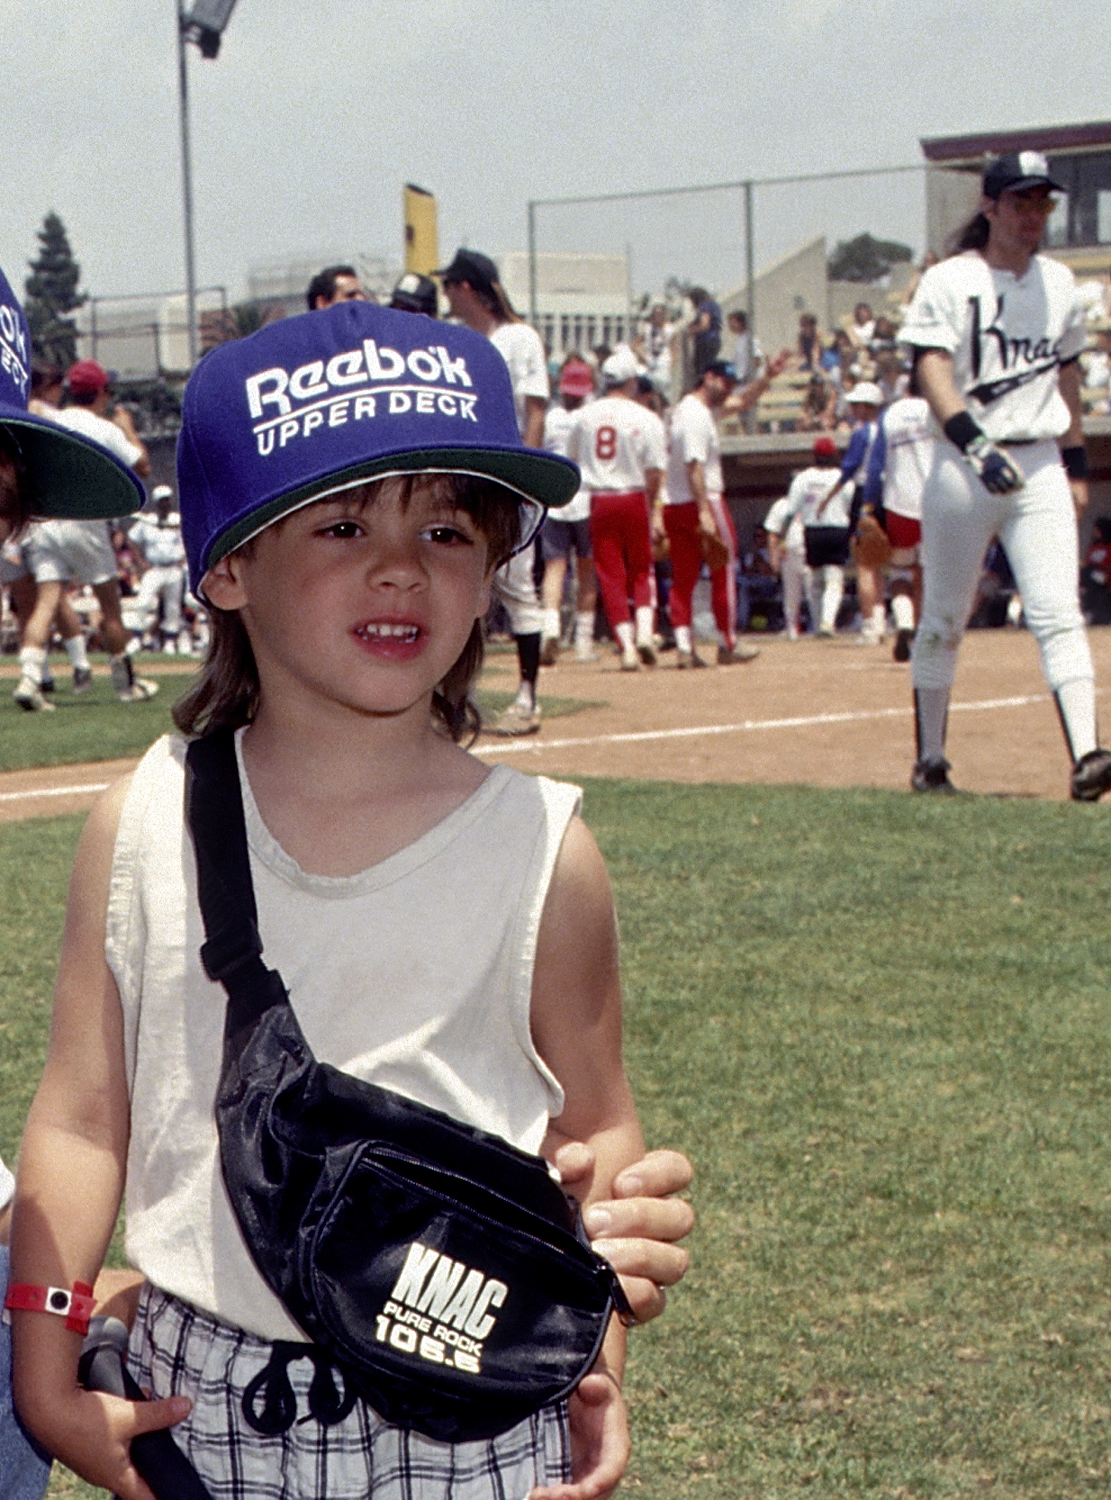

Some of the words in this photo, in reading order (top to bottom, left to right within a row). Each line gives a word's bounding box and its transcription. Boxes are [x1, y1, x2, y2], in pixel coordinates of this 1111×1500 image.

[245, 338, 473, 418] Reebok
[257, 396, 377, 456] UPPER
[388, 391, 479, 423] DECK
[595, 425, 616, 461] 8
[391, 1241, 509, 1340] KNAC
[383, 1301, 433, 1333] PURE
[433, 1324, 484, 1357] ROCK
